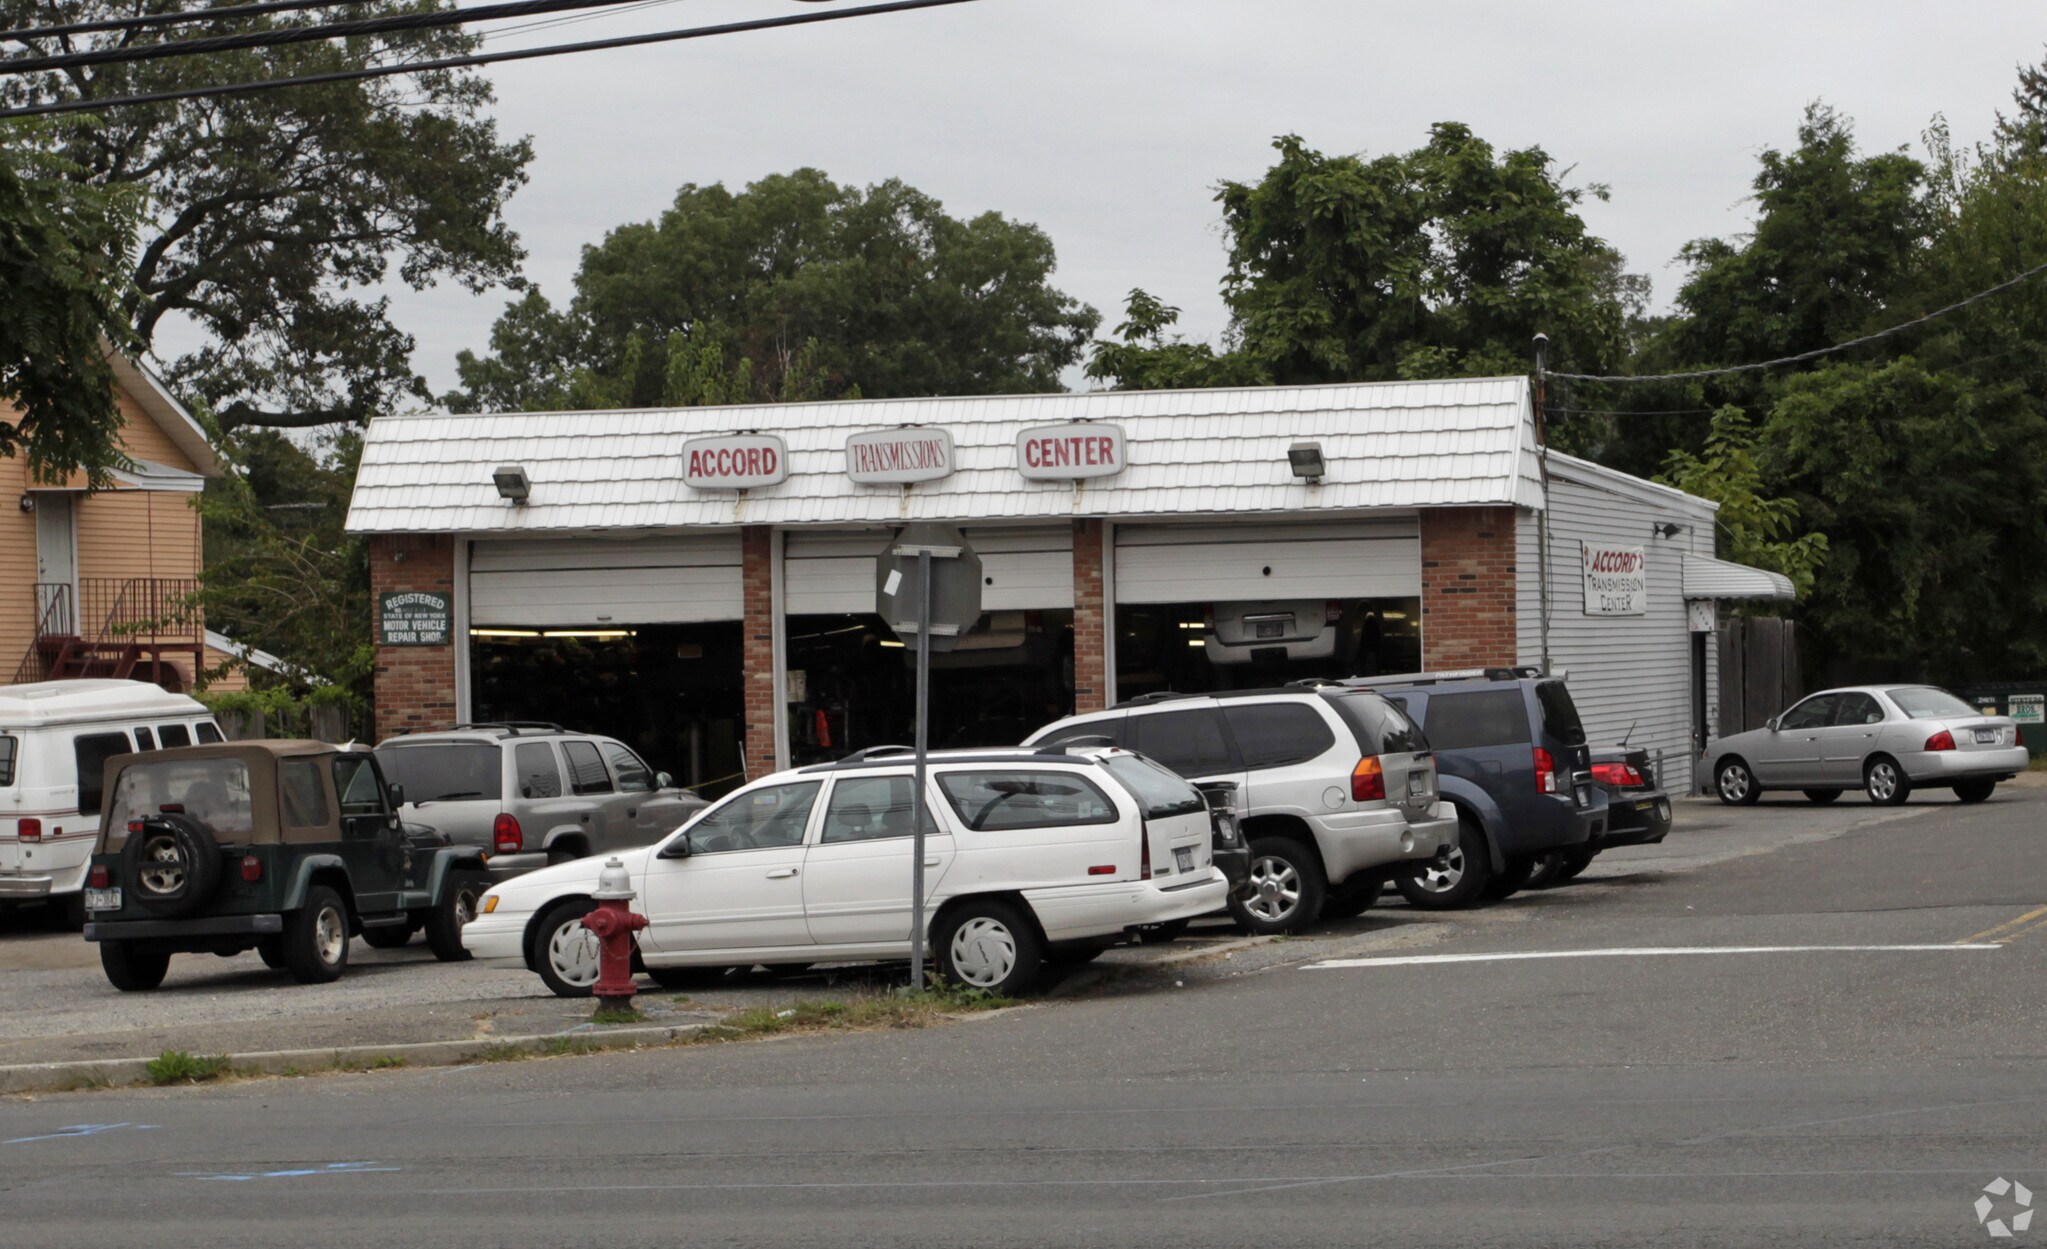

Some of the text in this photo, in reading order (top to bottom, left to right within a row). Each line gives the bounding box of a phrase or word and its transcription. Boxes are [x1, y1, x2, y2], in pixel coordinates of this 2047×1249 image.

[852, 439, 946, 474] TRANSMISSIONS
[1025, 436, 1115, 468] CENTER
[688, 447, 777, 478] ACCORD
[1592, 551, 1637, 573] ACCORD
[1586, 574, 1644, 592] TRANSMISSION
[385, 593, 445, 610] REGISTERED
[1600, 594, 1632, 612] CENTER
[383, 612, 447, 620] STATE OF NEW YORK
[383, 620, 447, 631] MOTOR VEHICLE
[387, 631, 441, 643] REPAIR SHOP
